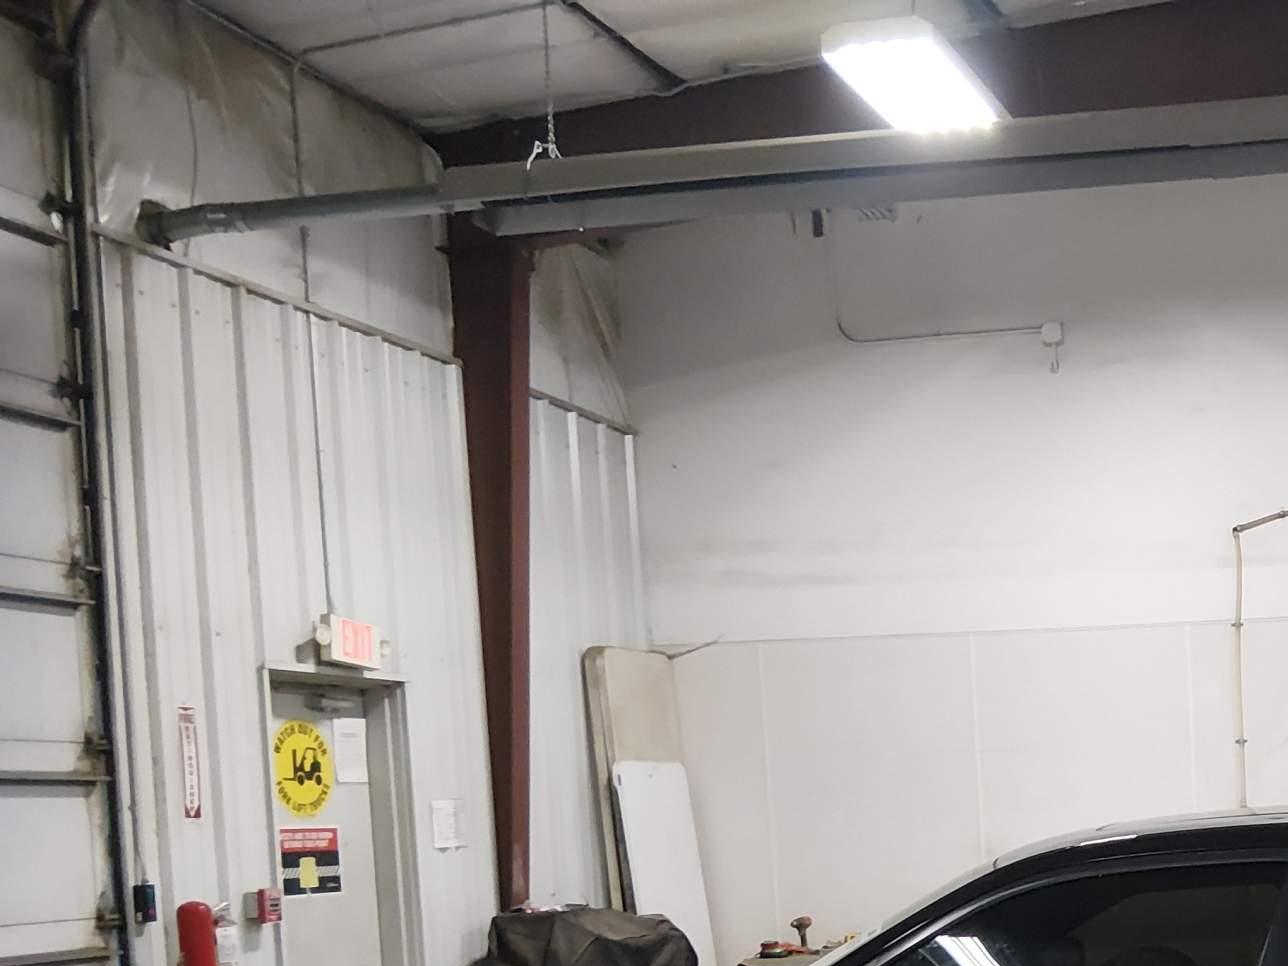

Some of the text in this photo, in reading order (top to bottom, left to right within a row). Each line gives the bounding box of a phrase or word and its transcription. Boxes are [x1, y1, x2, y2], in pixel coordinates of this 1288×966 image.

[342, 619, 373, 661] EXIT
[274, 724, 296, 754] WATCH
[298, 723, 313, 738] OUT
[313, 734, 327, 757] FOR
